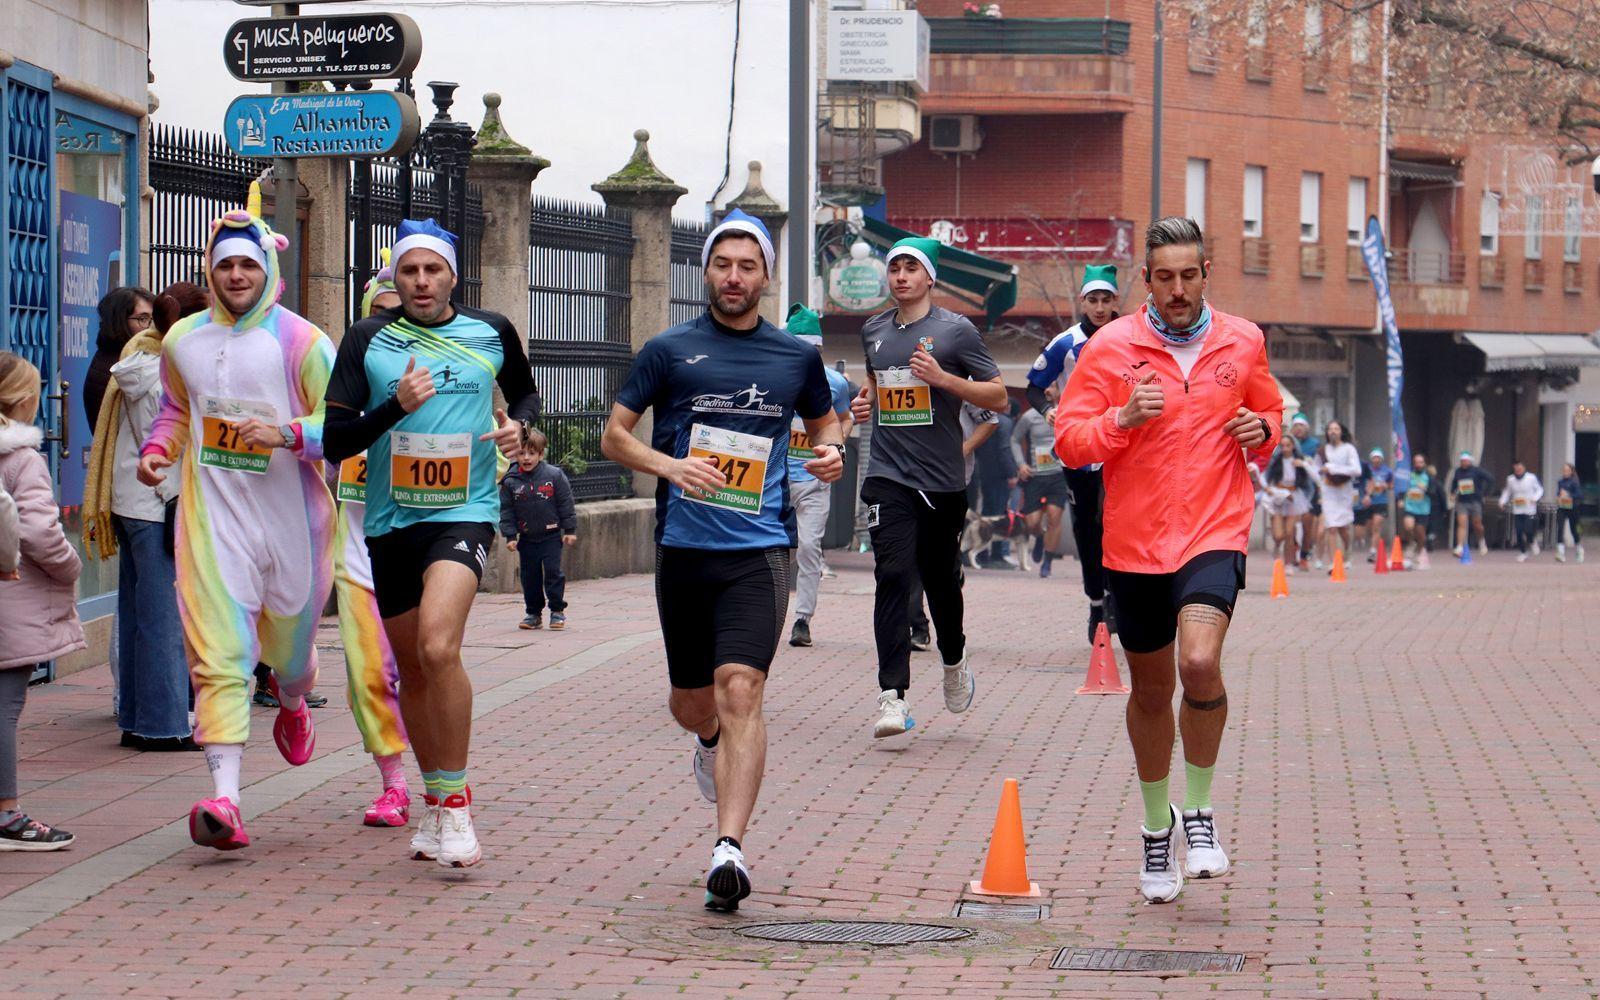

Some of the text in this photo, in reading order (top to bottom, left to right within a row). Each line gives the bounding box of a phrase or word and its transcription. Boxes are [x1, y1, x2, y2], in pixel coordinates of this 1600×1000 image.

[853, 17, 903, 25] PRUDENCIO
[254, 21, 395, 58] MUSA peluqueros
[262, 66, 298, 74] ALFONSO
[271, 97, 289, 114] En
[292, 97, 327, 111] Madrigal
[327, 97, 334, 107] de
[336, 97, 343, 106] la
[292, 111, 390, 134] Alhambra
[271, 135, 383, 154] Restaurante
[887, 389, 915, 409] 175
[897, 413, 928, 421] EXTREMADURA
[217, 422, 253, 451] 27
[203, 452, 267, 469] JUNTA DE EXTREMADURA
[410, 460, 452, 487] 100
[342, 487, 366, 498] JUNTA DE
[394, 490, 465, 501] JUNTA DE EXTREMADURA
[715, 492, 758, 507] EXTREMADURA
